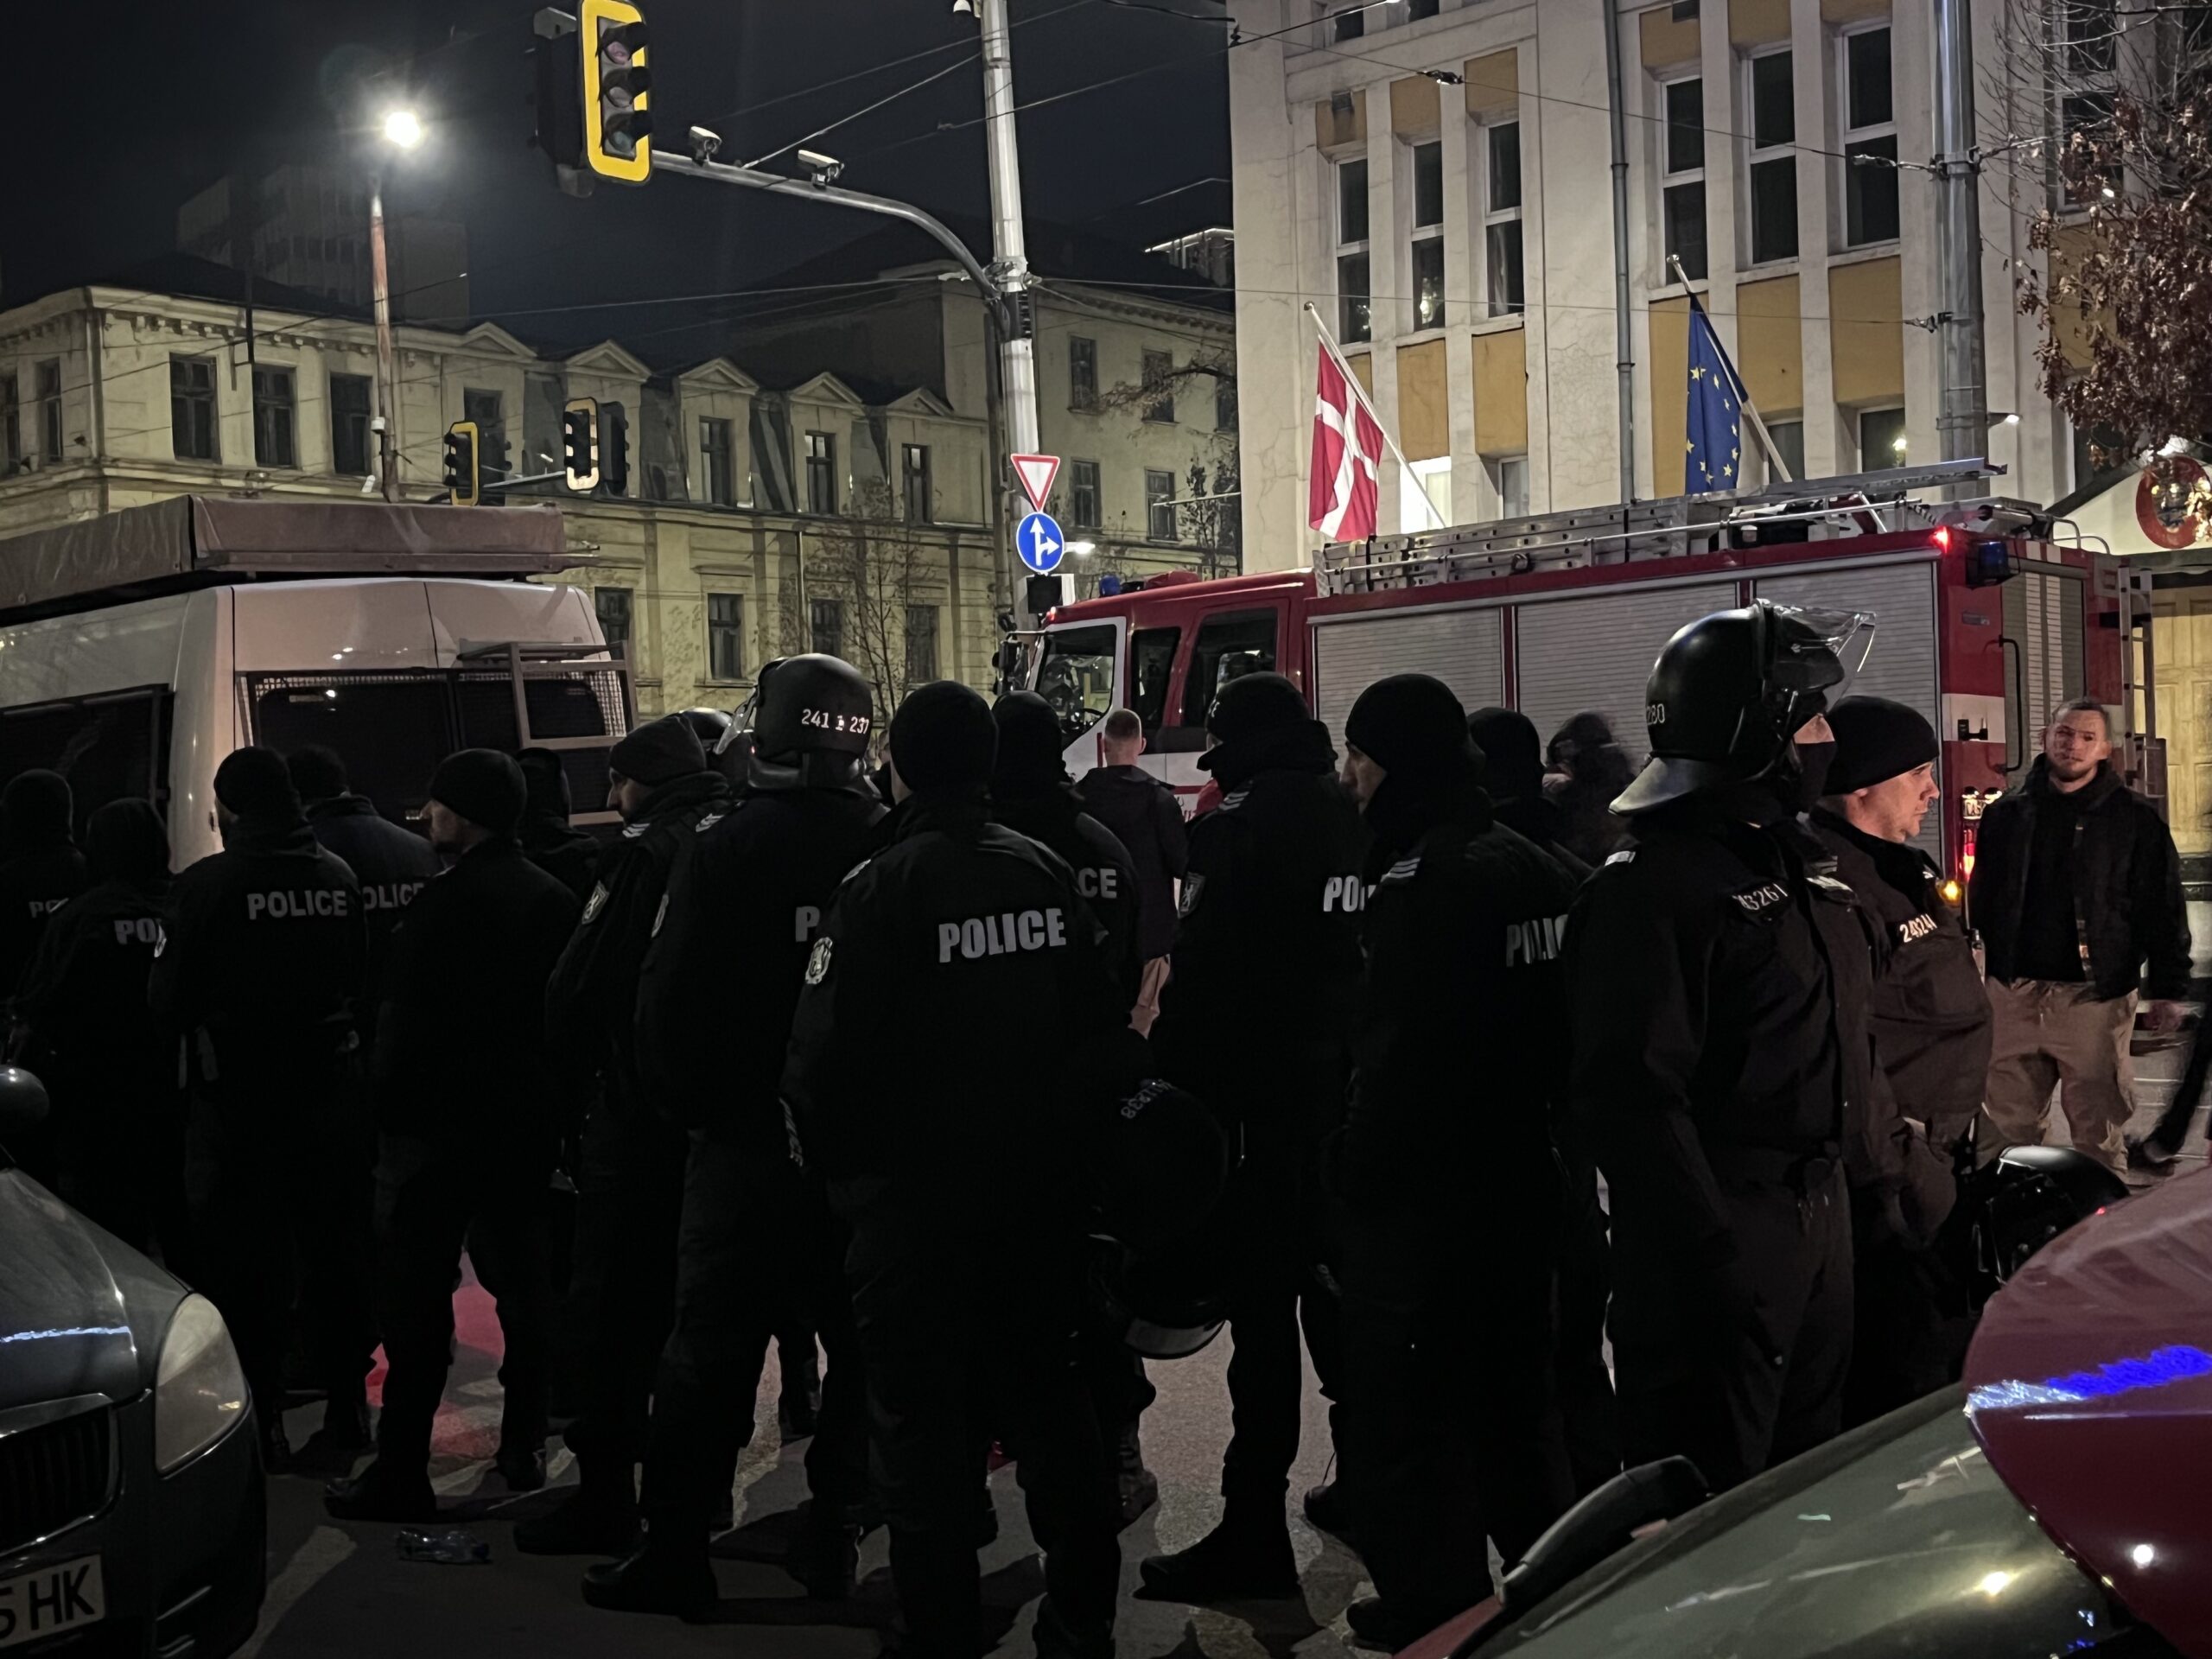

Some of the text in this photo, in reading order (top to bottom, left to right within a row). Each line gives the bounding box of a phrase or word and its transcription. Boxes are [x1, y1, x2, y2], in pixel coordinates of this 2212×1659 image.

[802, 708, 830, 728] 241
[246, 889, 348, 921] POLICE
[1323, 874, 1377, 912] PO
[112, 917, 162, 946] PO
[938, 907, 1068, 964] POLICE
[29, 1564, 95, 1631] HK
